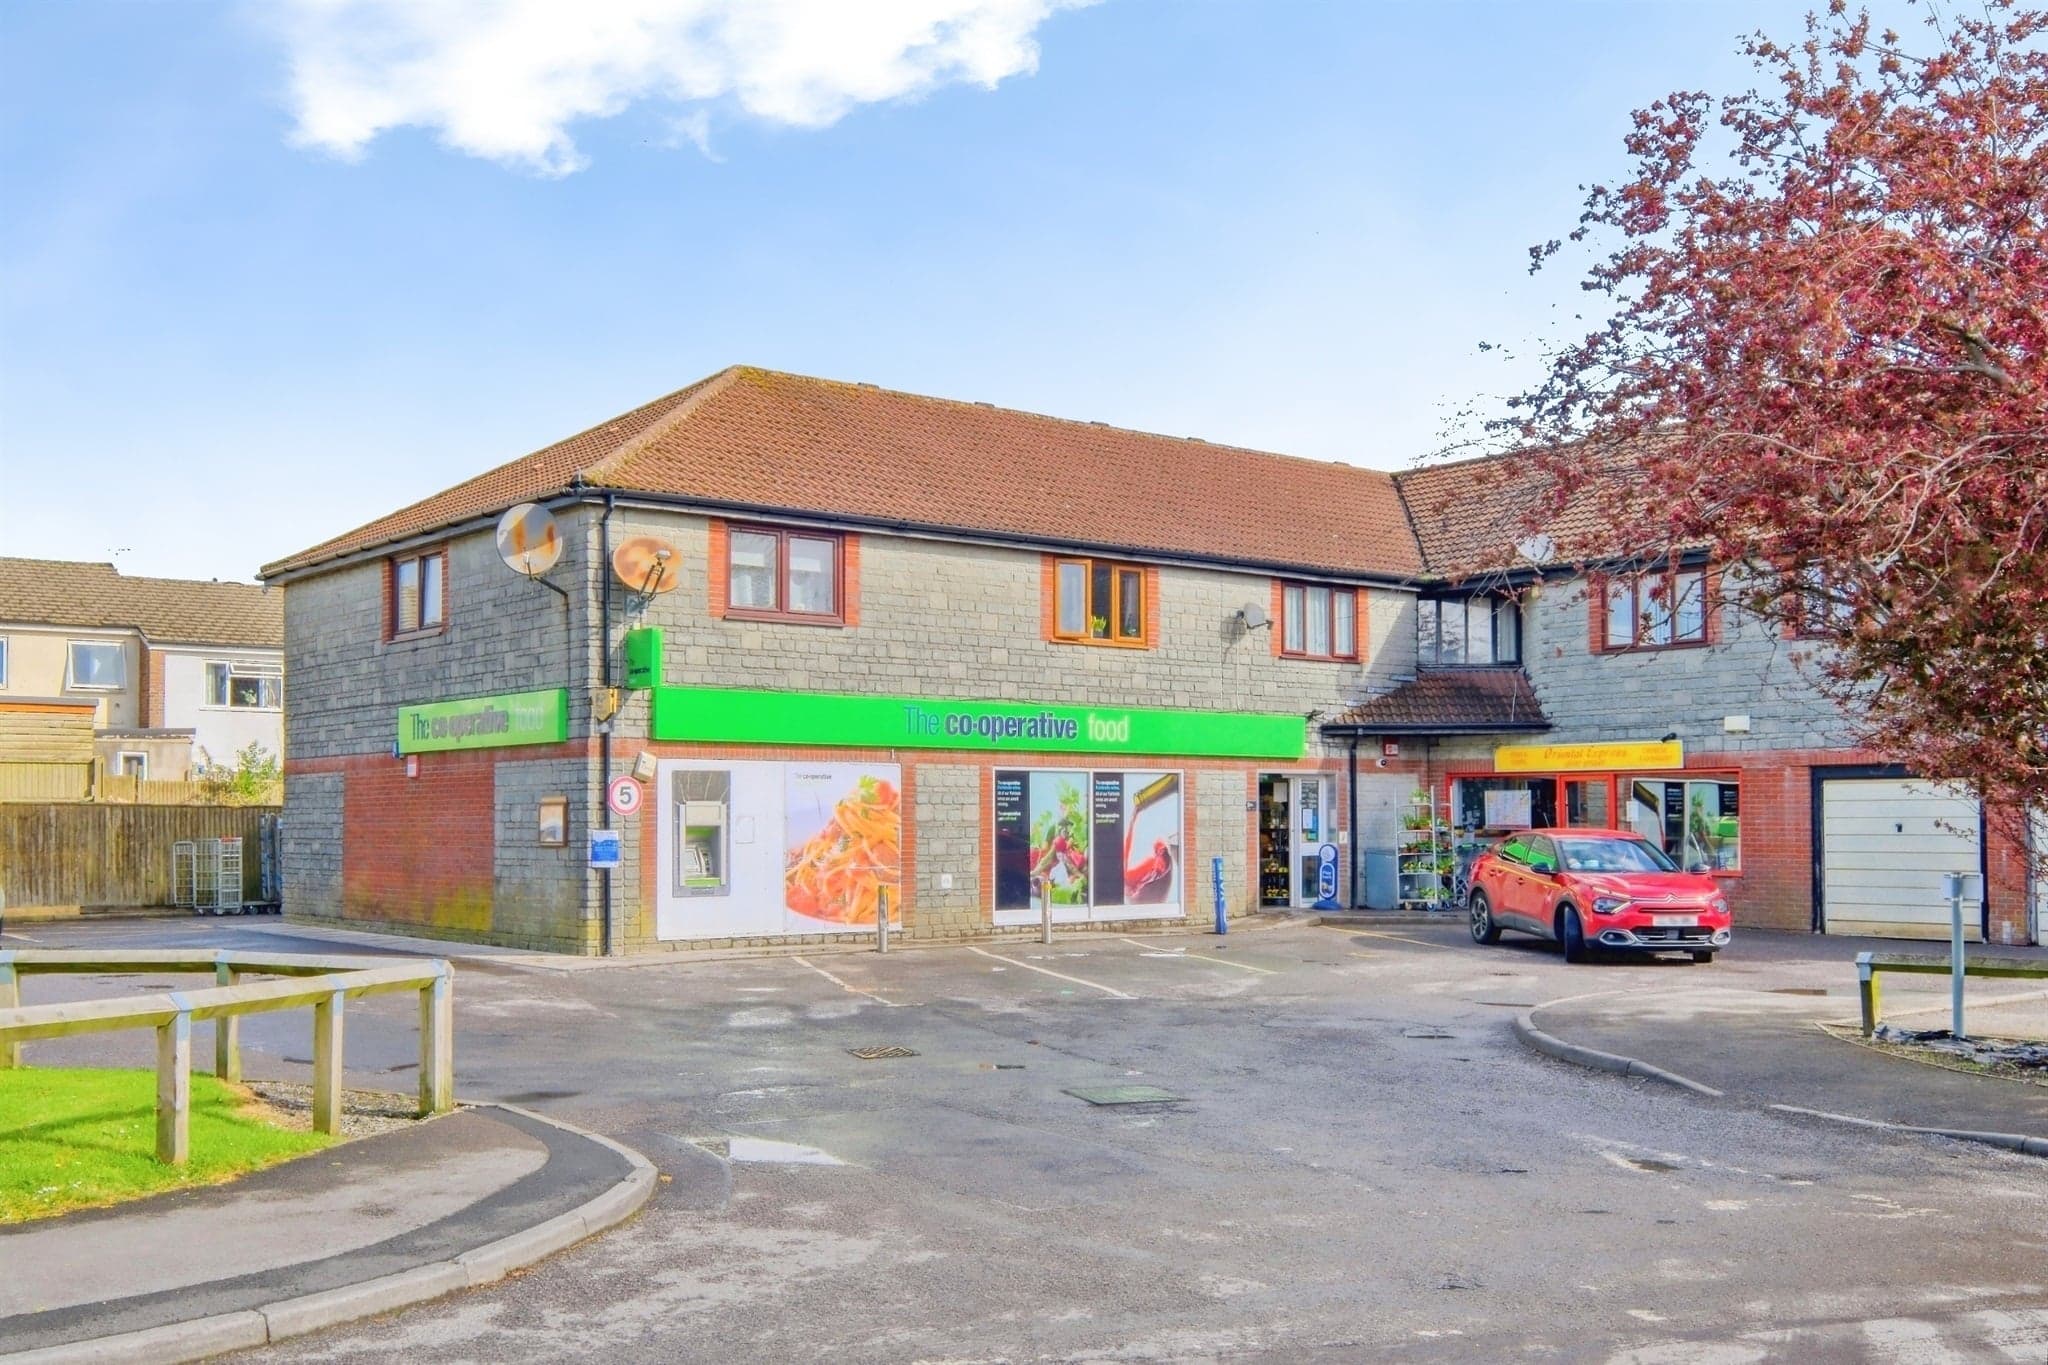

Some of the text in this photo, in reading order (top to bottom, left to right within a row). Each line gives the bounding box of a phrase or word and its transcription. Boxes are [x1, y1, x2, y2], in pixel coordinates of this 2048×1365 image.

[410, 713, 430, 741] The
[904, 705, 939, 735] The
[1088, 713, 1129, 742] food
[620, 786, 632, 805] 5
